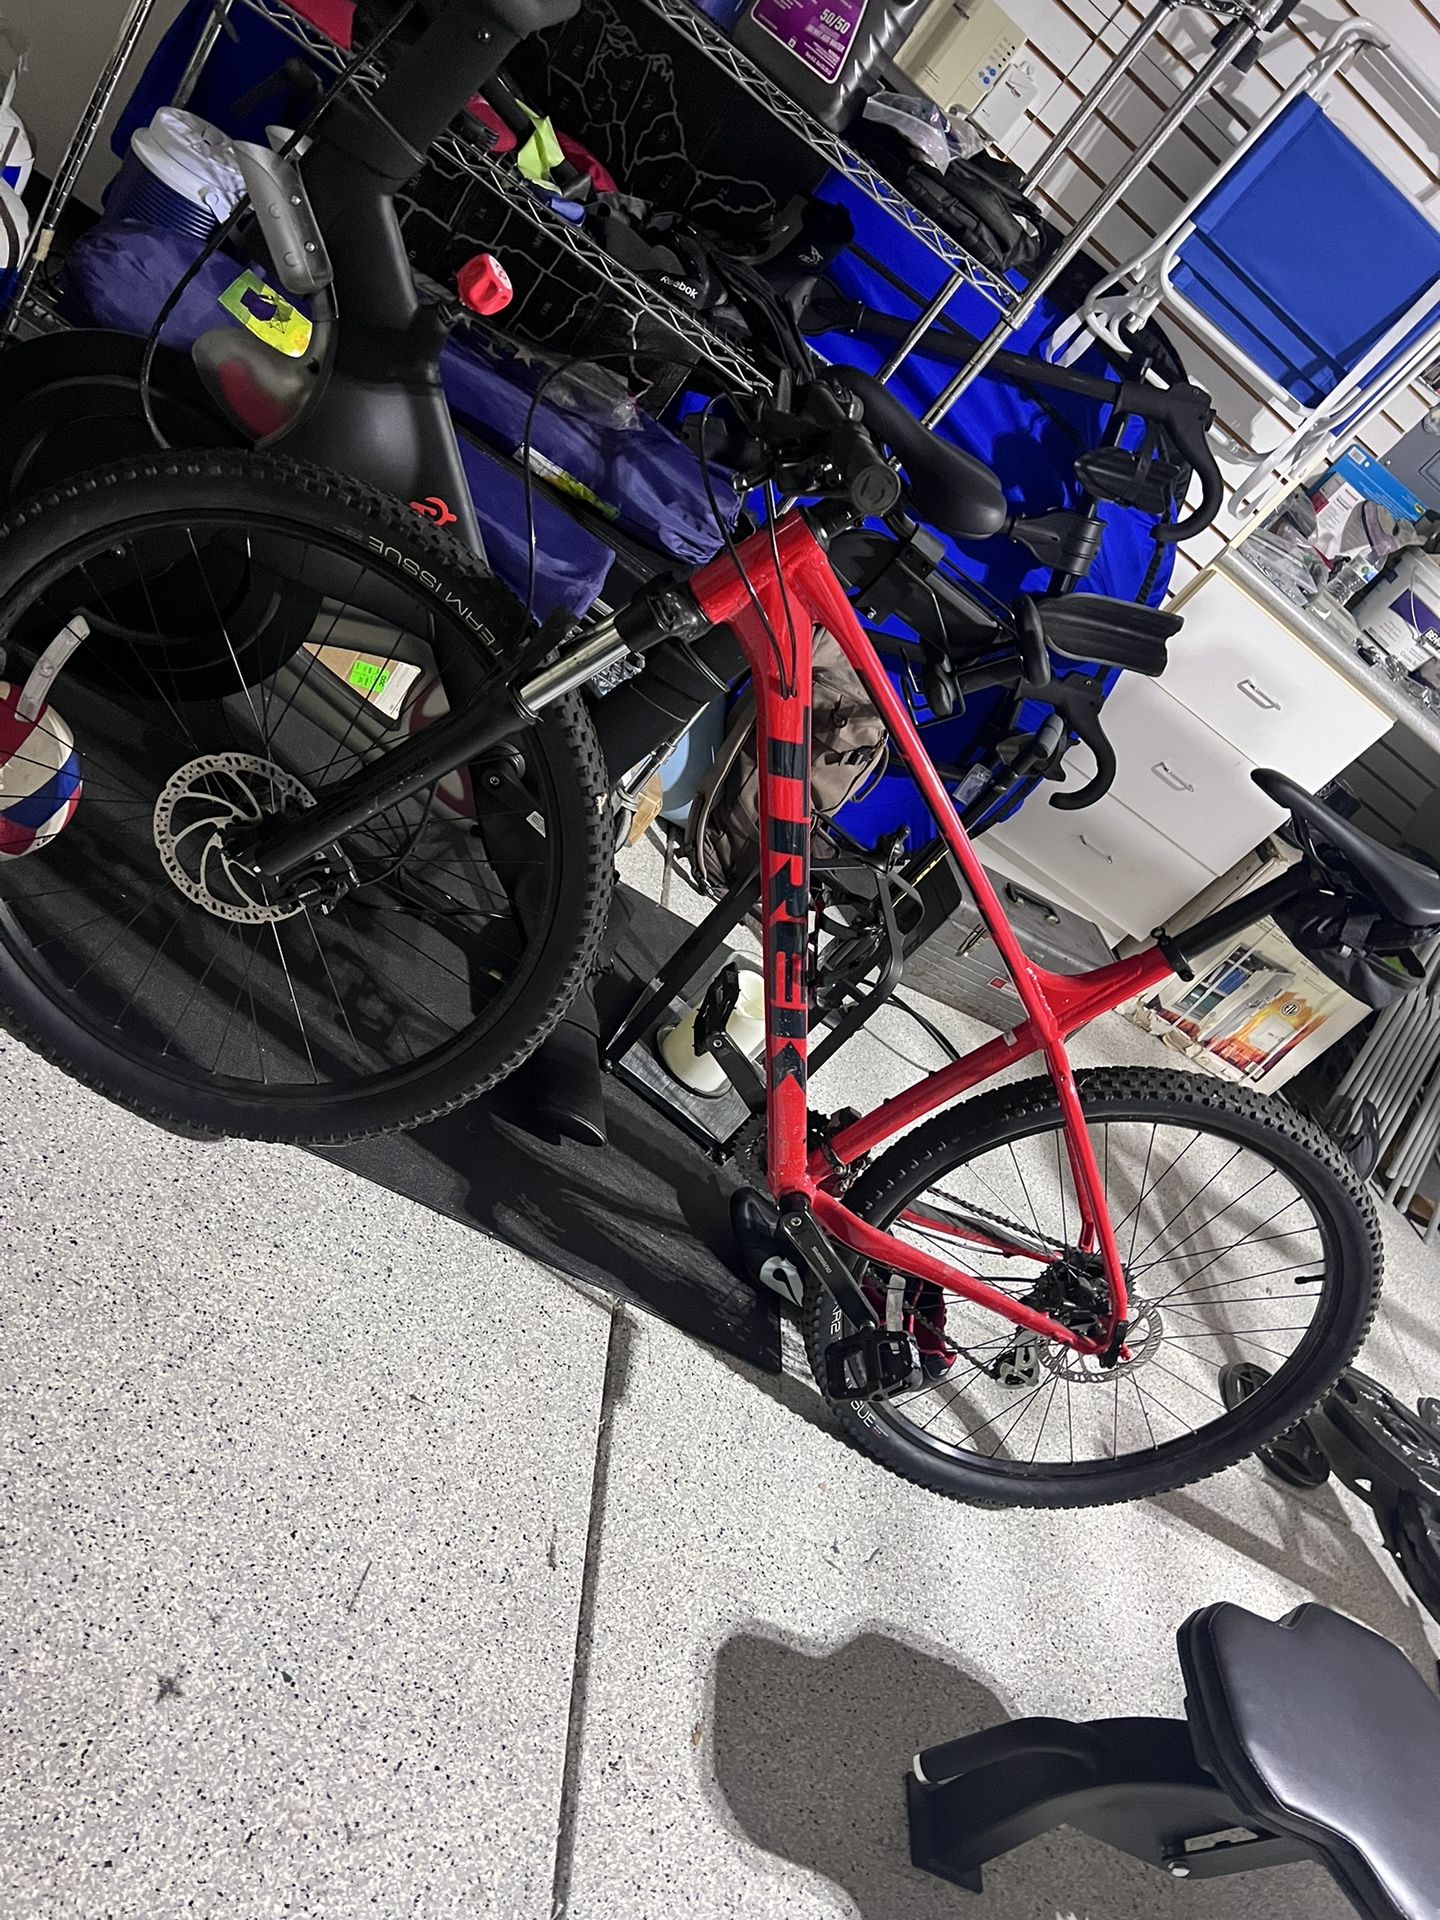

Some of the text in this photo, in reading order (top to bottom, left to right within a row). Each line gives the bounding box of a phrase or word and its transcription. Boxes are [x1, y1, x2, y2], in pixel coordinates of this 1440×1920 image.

[819, 8, 852, 35] 50/50
[659, 275, 699, 300] Reebok
[367, 535, 443, 592] ISSUE
[767, 706, 810, 1094] TREK
[850, 1400, 877, 1428] SUE
